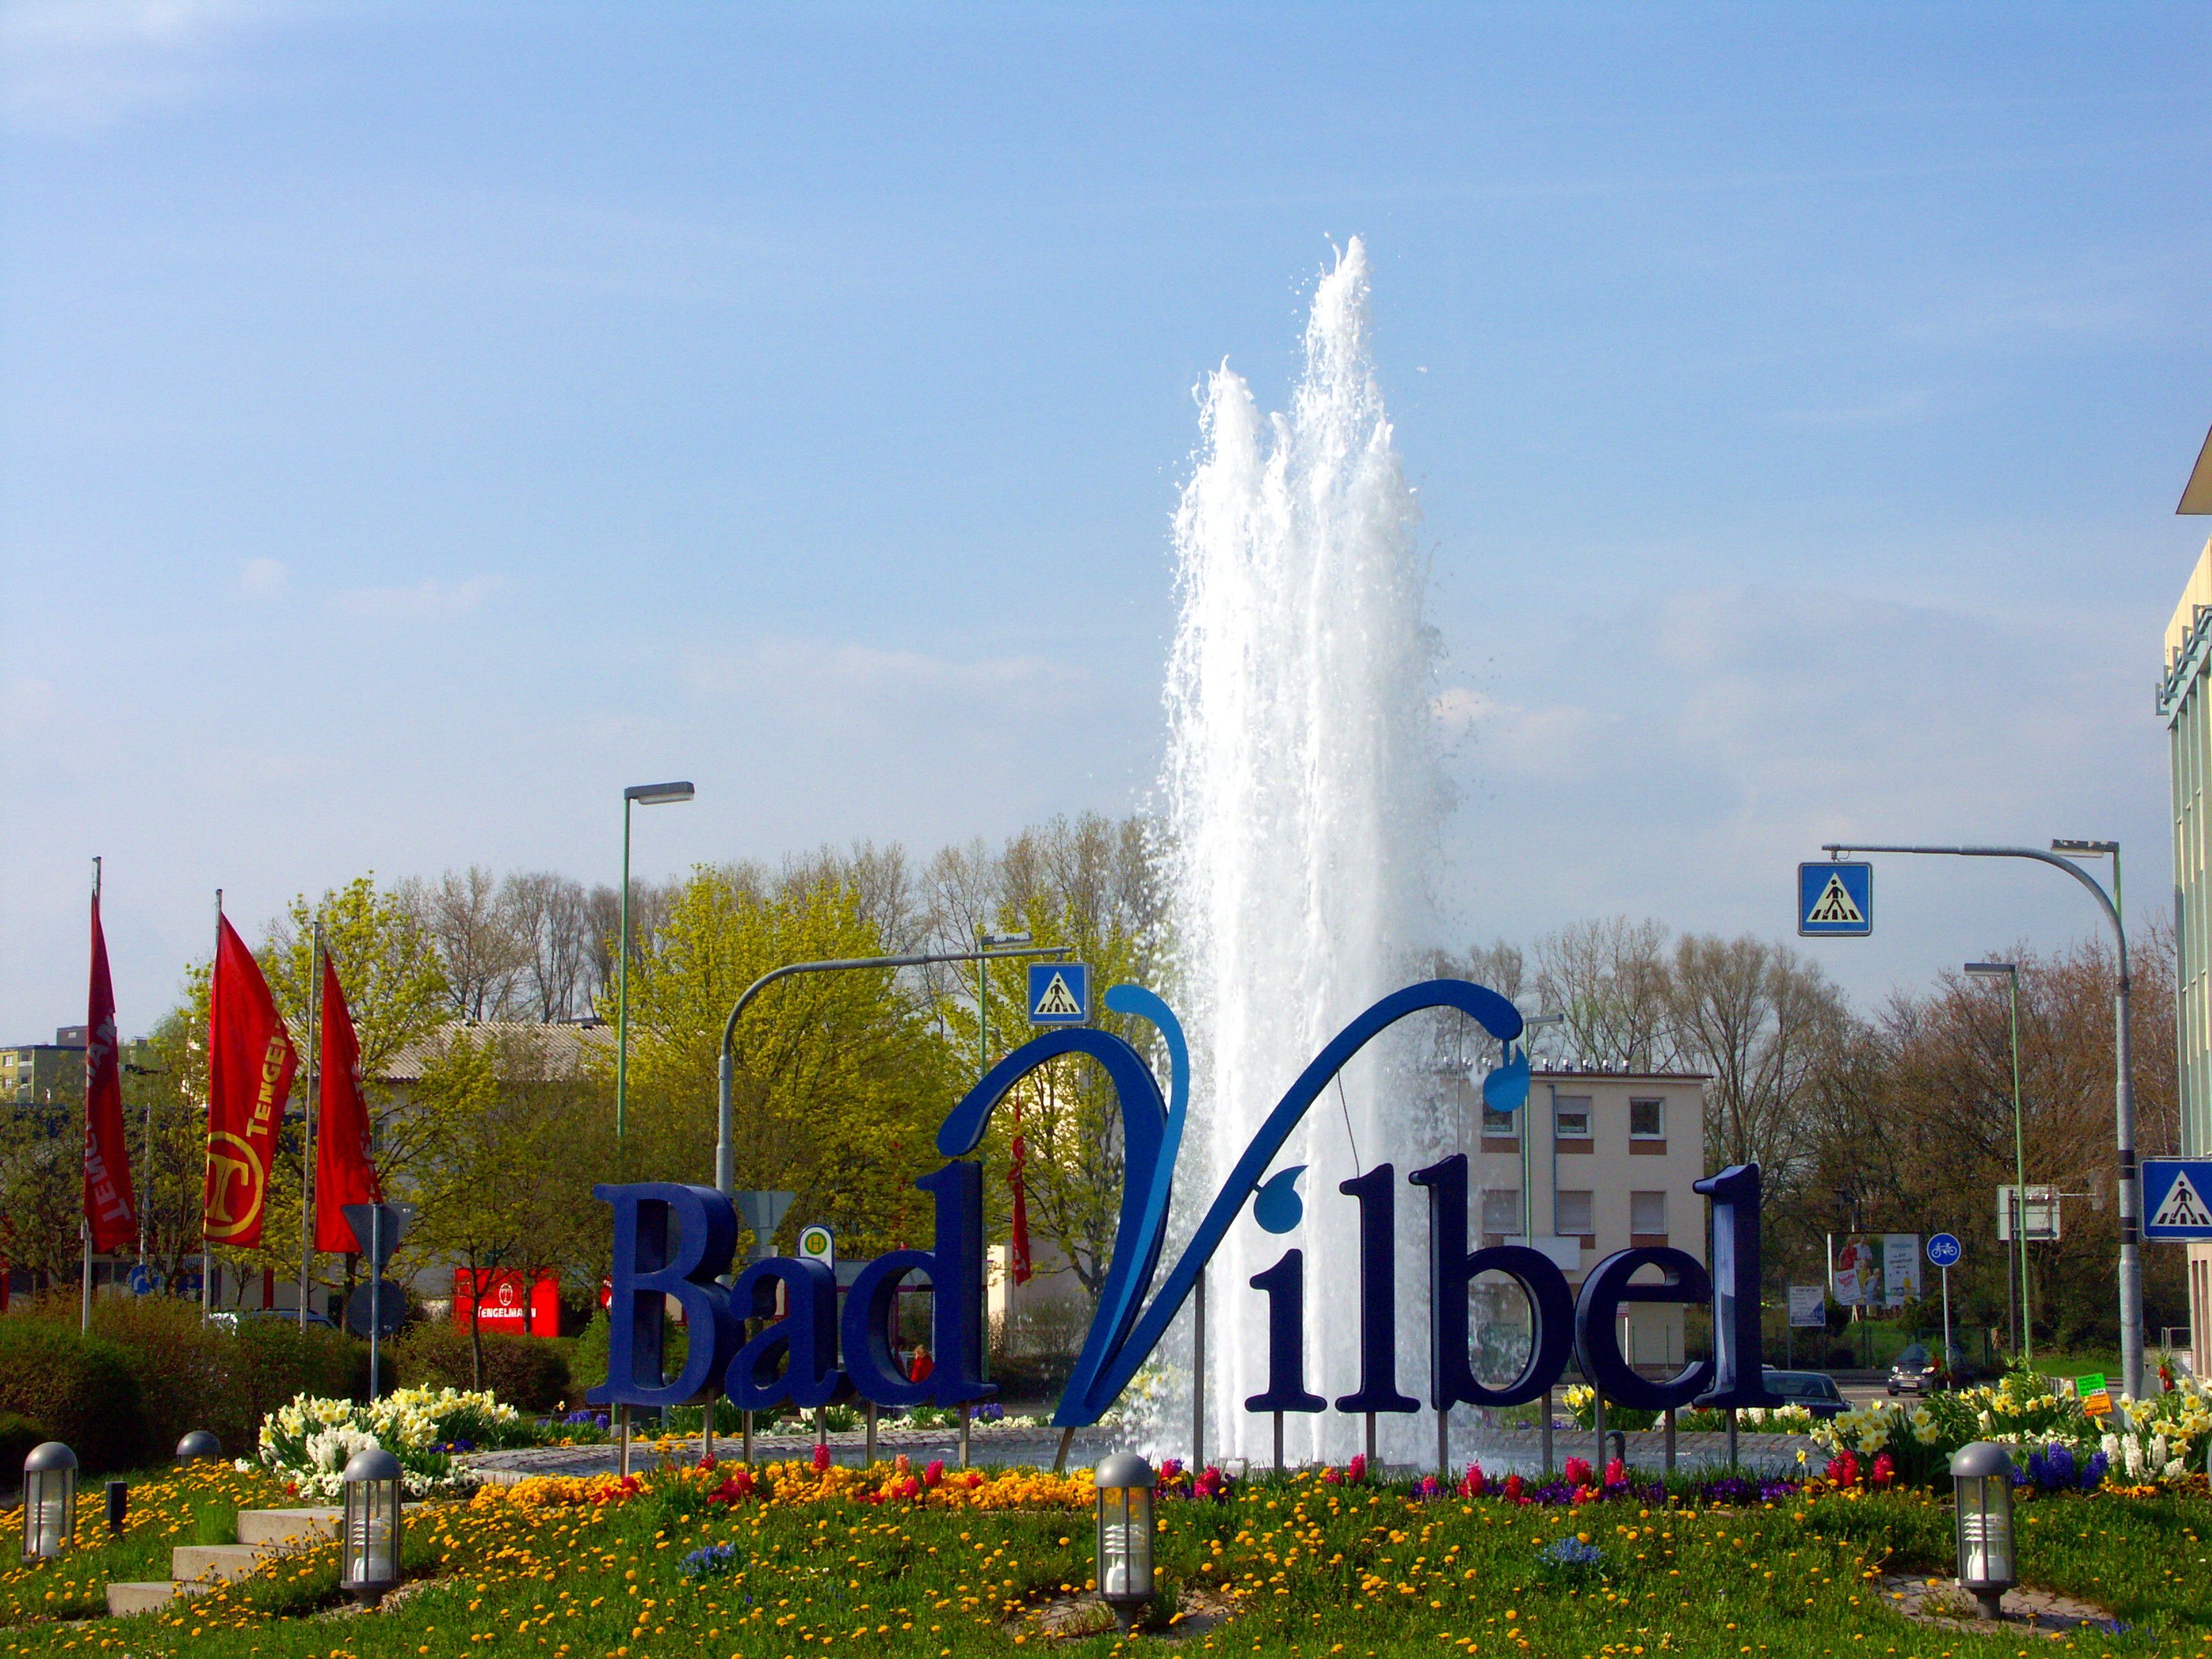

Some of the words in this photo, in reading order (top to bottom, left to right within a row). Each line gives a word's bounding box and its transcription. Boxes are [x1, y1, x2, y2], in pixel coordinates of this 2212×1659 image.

[478, 1306, 536, 1317] TENGELMAN
[586, 1159, 998, 1412] Bad
[938, 979, 1784, 1427] Vilbel
